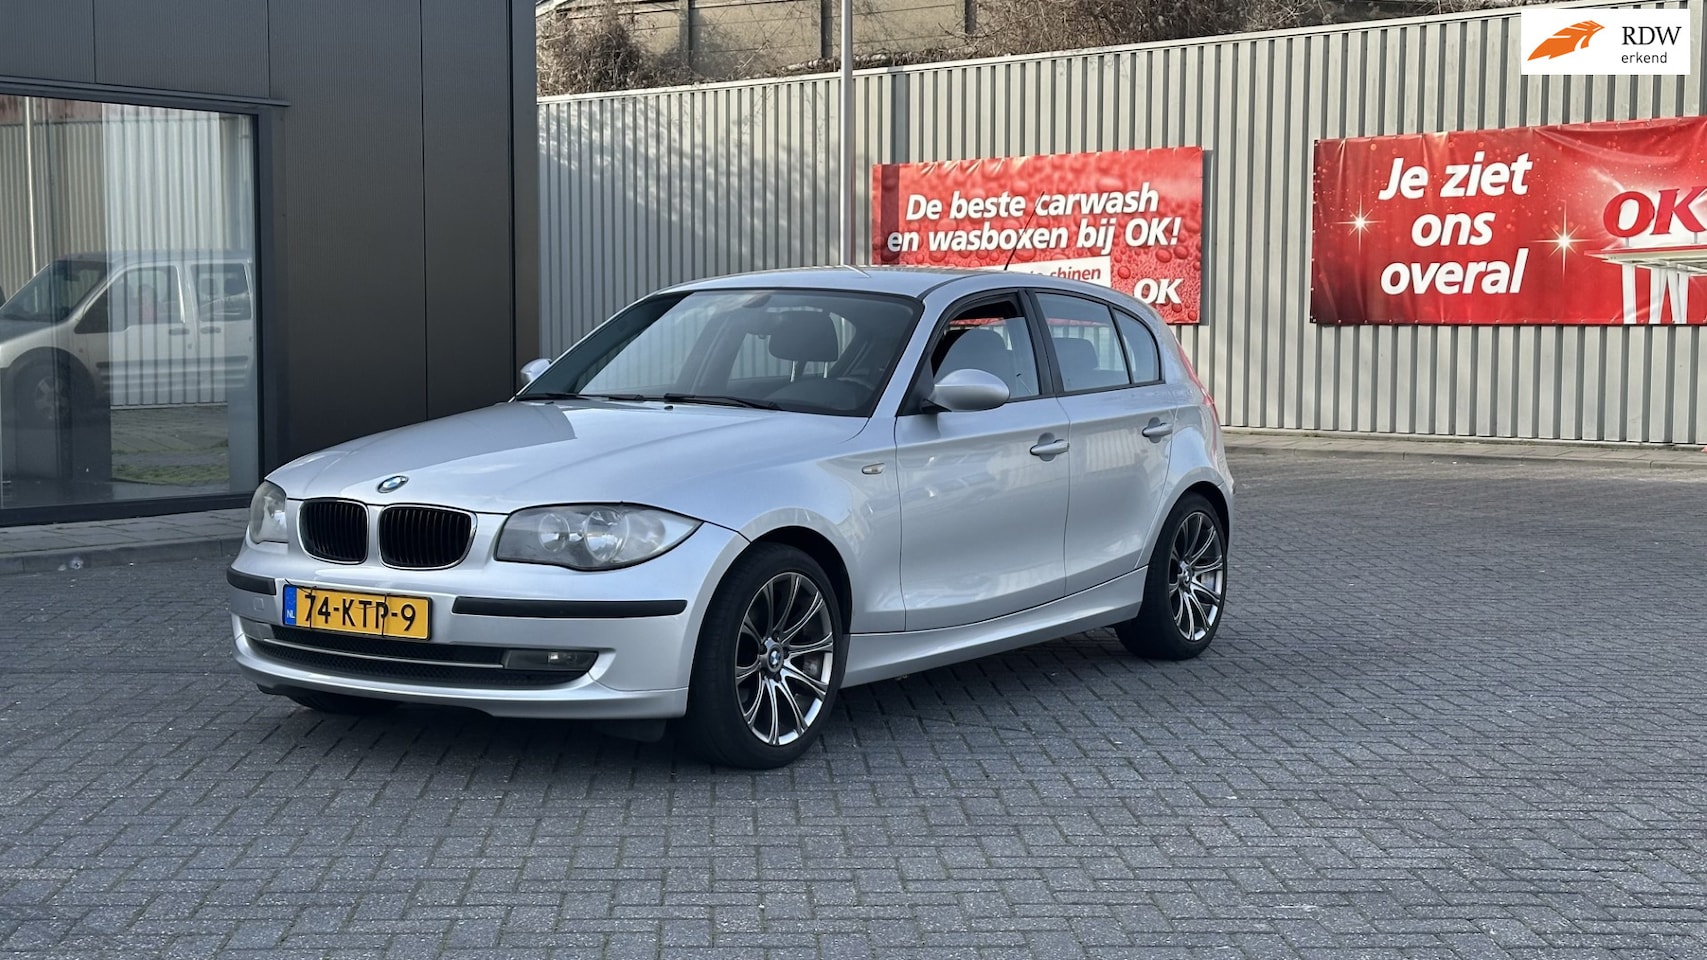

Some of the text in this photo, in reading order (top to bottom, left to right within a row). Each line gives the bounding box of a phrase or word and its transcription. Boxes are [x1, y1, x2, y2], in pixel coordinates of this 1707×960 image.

[1378, 151, 1533, 201] Je ziet
[906, 182, 1159, 221] De beste carwash
[1603, 186, 1707, 238] OK
[887, 217, 1182, 256] en wasboxen bij OK!
[1410, 211, 1496, 248] ons
[1133, 277, 1182, 305] OK
[1380, 248, 1530, 295] overal
[286, 609, 296, 619] NL
[304, 594, 416, 631] 74-KTP-9
